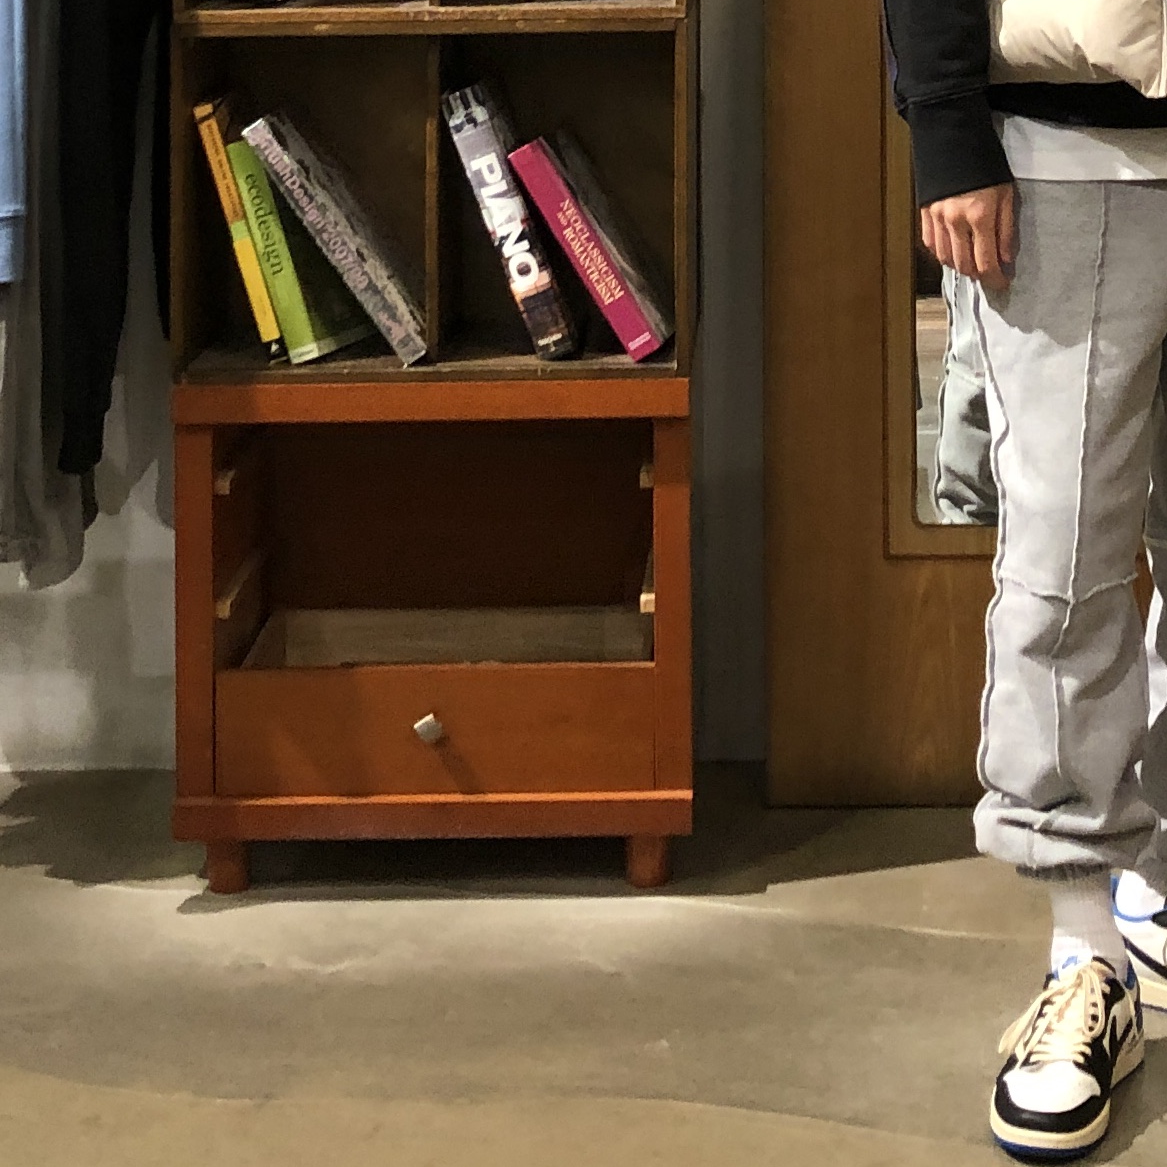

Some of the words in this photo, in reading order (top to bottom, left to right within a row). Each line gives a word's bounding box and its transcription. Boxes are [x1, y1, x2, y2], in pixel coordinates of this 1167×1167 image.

[245, 173, 284, 276] ecodesign
[469, 152, 541, 293] PIANO
[559, 199, 626, 302] NEOCLASSICISM
[562, 225, 615, 305] ROMANTICISM
